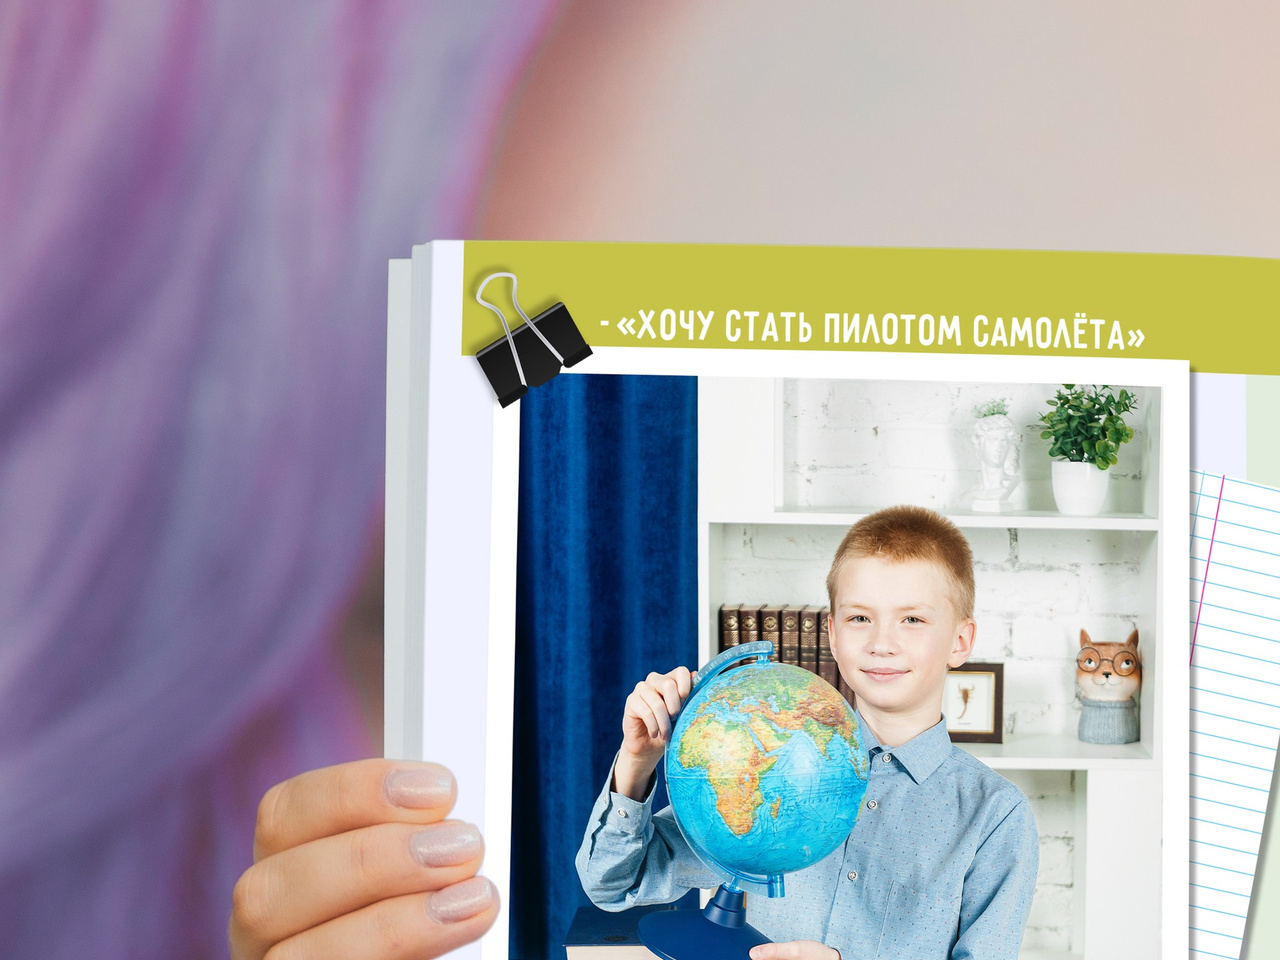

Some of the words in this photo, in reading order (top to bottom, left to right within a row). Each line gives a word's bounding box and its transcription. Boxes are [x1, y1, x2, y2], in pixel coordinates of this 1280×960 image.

[616, 308, 715, 341] «ХОЧУ
[725, 309, 812, 343] СТАТЬ
[824, 312, 962, 346] ПИЛОТОМ
[973, 311, 1146, 350] САМОЛЁТА»
